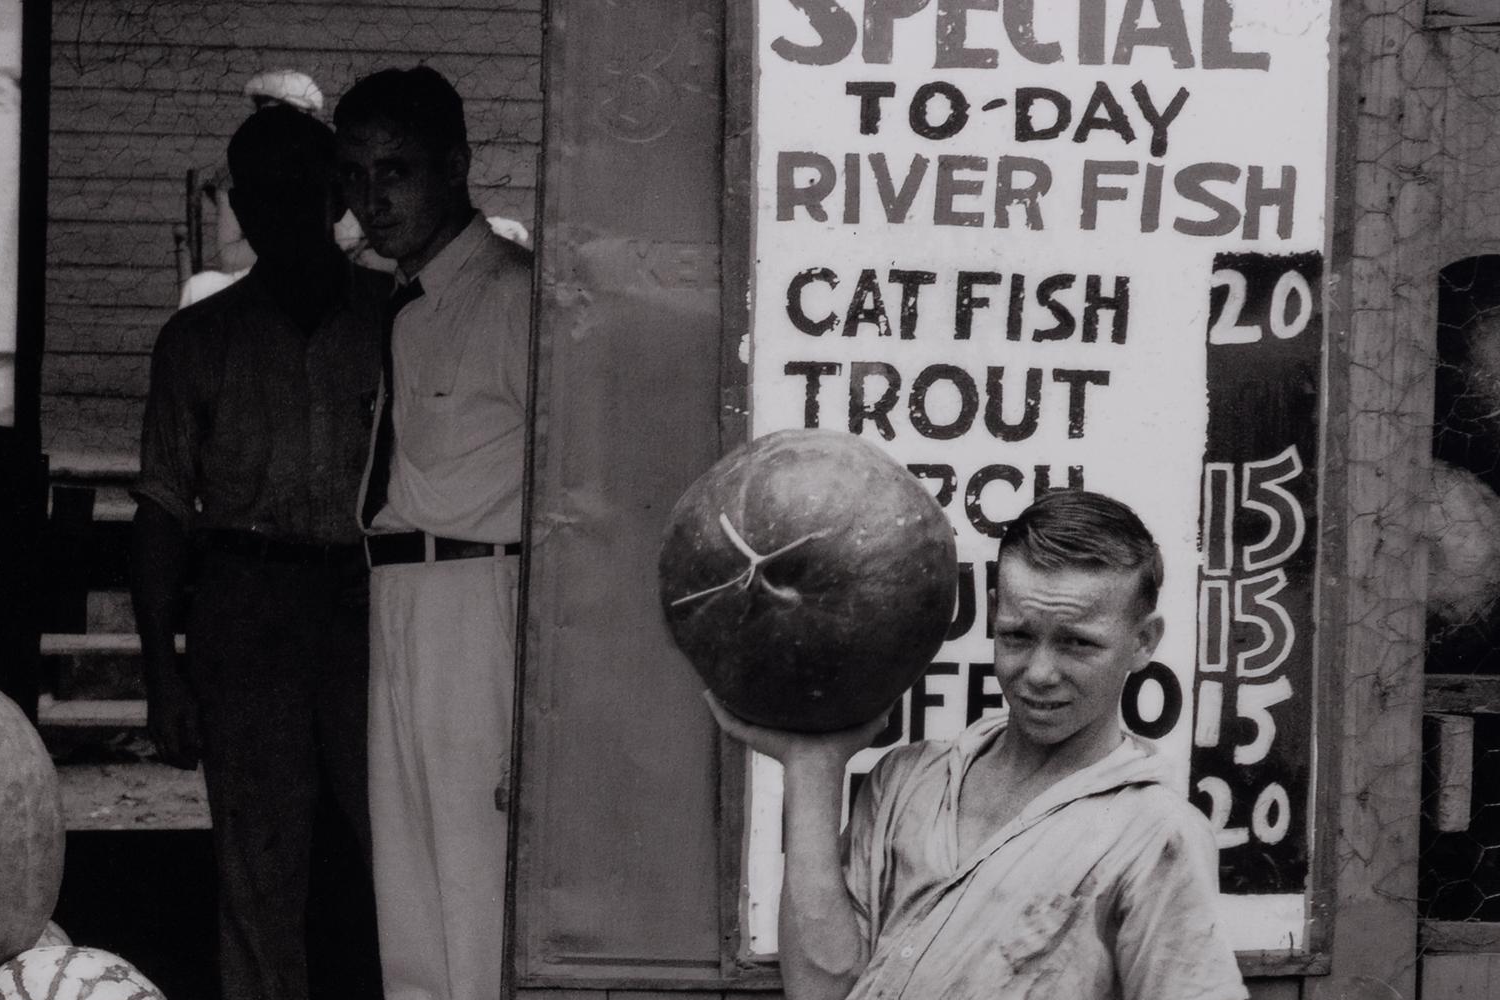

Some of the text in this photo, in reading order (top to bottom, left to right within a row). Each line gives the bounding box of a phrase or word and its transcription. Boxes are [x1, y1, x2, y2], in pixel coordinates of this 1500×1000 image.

[771, 0, 1272, 72] SPECIAL
[845, 80, 1190, 157] TO-DAY
[776, 150, 1298, 241] RIVER FISH
[1209, 270, 1313, 345] 20
[784, 361, 1110, 442] TROUT
[1204, 445, 1305, 576] 15
[1199, 569, 1295, 678] 15
[1194, 676, 1293, 765] 15
[1198, 777, 1291, 850] 20
